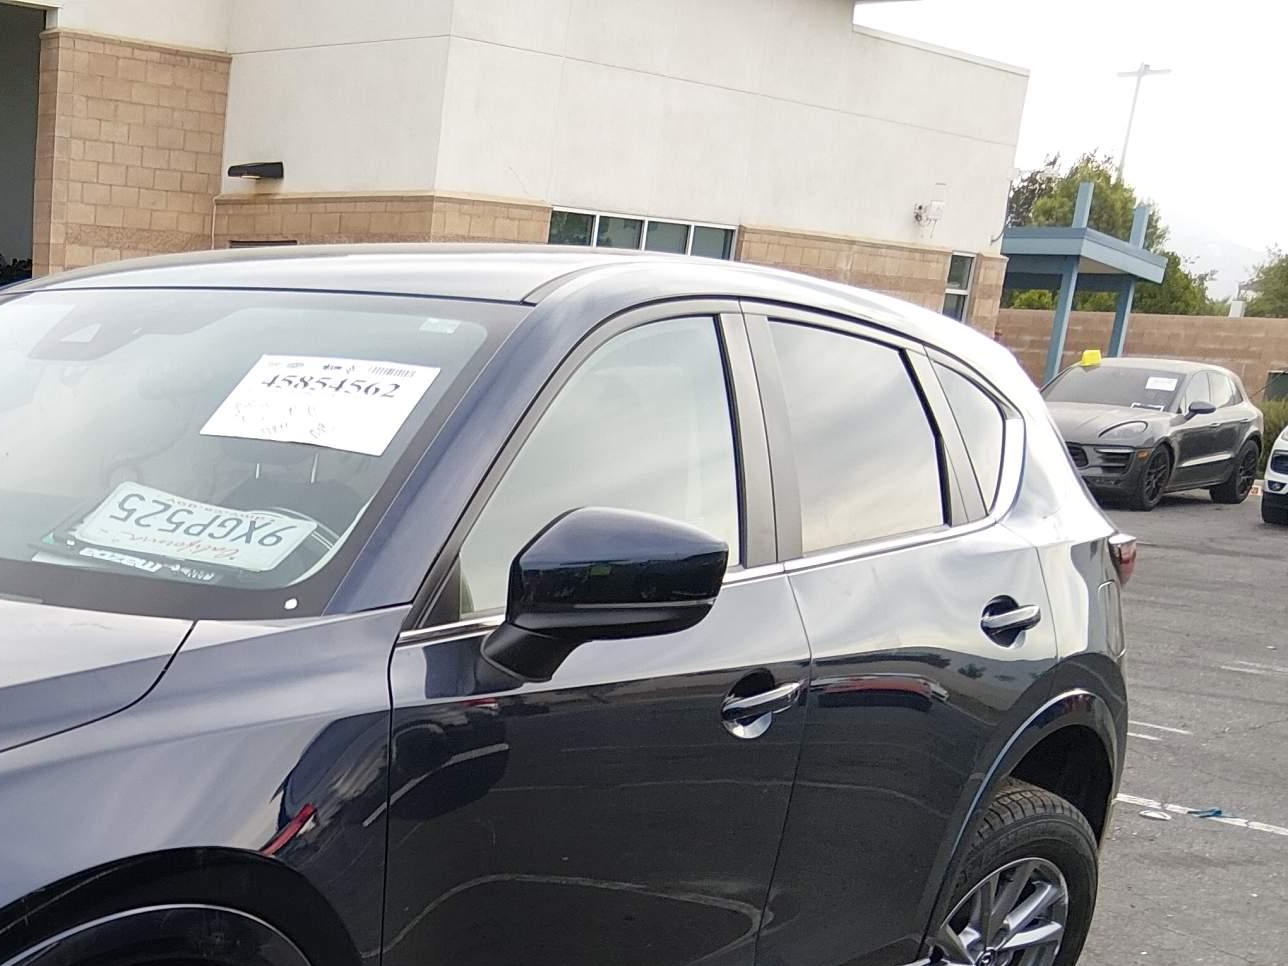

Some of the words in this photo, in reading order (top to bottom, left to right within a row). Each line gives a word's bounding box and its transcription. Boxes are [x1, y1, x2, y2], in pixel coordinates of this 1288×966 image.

[261, 374, 401, 399] 45854562
[109, 493, 298, 547] 9XGP525
[121, 532, 241, 560] California
